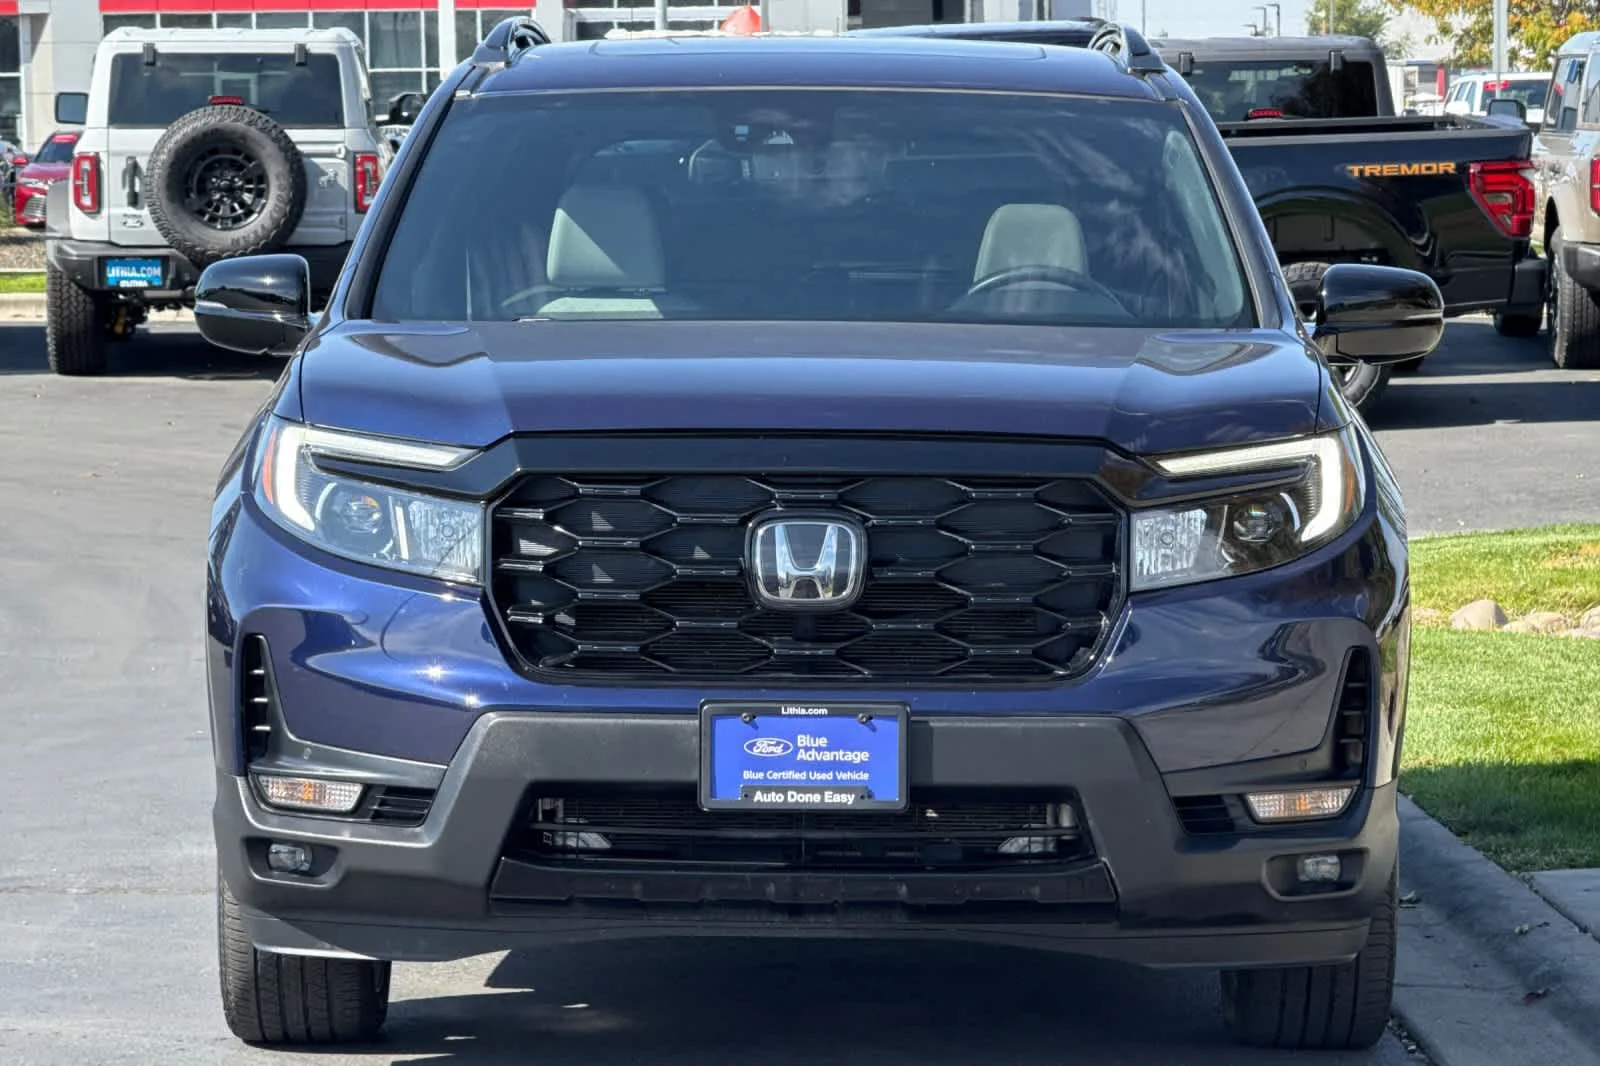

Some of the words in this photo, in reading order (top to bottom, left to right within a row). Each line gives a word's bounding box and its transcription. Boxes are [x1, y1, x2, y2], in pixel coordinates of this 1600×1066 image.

[1346, 162, 1456, 176] TREMOR
[107, 266, 162, 277] LITHIA.COM
[781, 706, 828, 715] Lithia.com
[797, 734, 828, 747] Blue
[797, 748, 870, 763] Advantage
[743, 770, 764, 780] Blue
[766, 770, 807, 780] Certified
[809, 770, 833, 780] Used
[835, 770, 869, 780] Vehicle
[754, 790, 785, 803] Auto
[787, 790, 821, 803] Done
[824, 790, 855, 805] Easy
